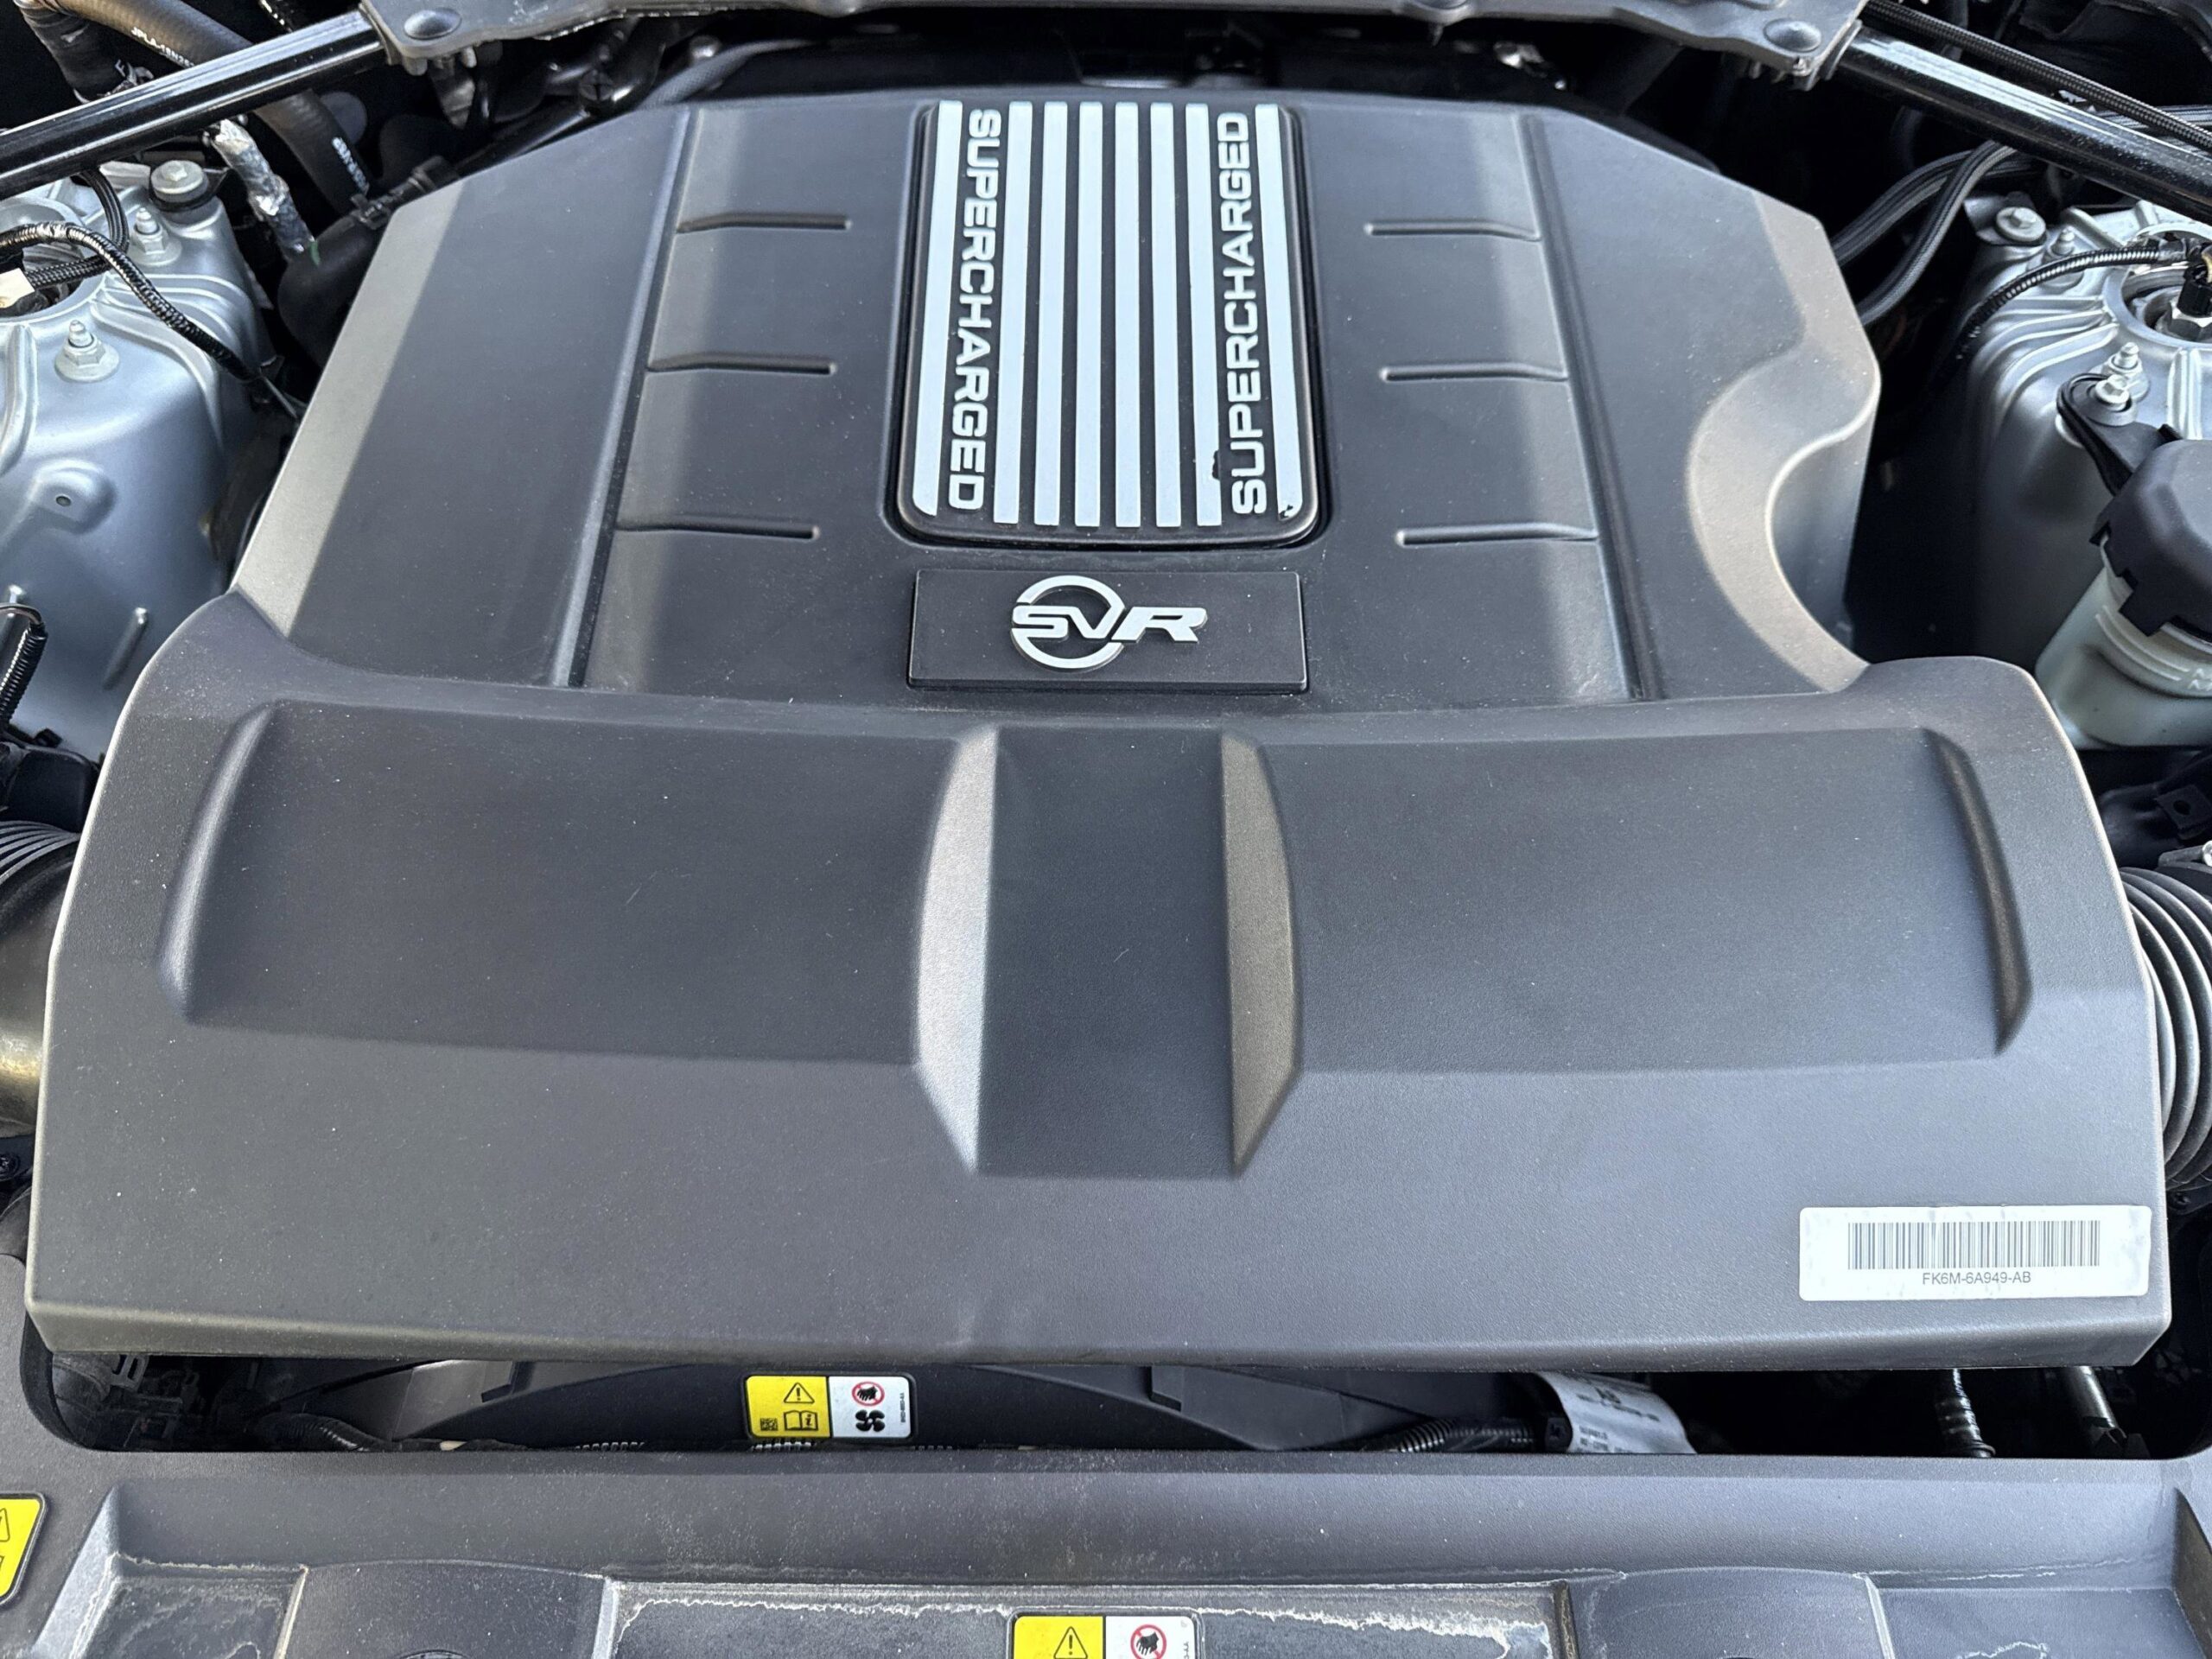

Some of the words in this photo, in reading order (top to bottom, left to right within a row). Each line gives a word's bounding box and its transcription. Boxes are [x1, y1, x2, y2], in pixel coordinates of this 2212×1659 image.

[949, 109, 1001, 512] SUPERCHARGED
[1217, 112, 1268, 515] SUPERCHARGED
[1012, 605, 1208, 644] SVR
[1922, 1271, 2032, 1285] FK6M-6A949-AB
